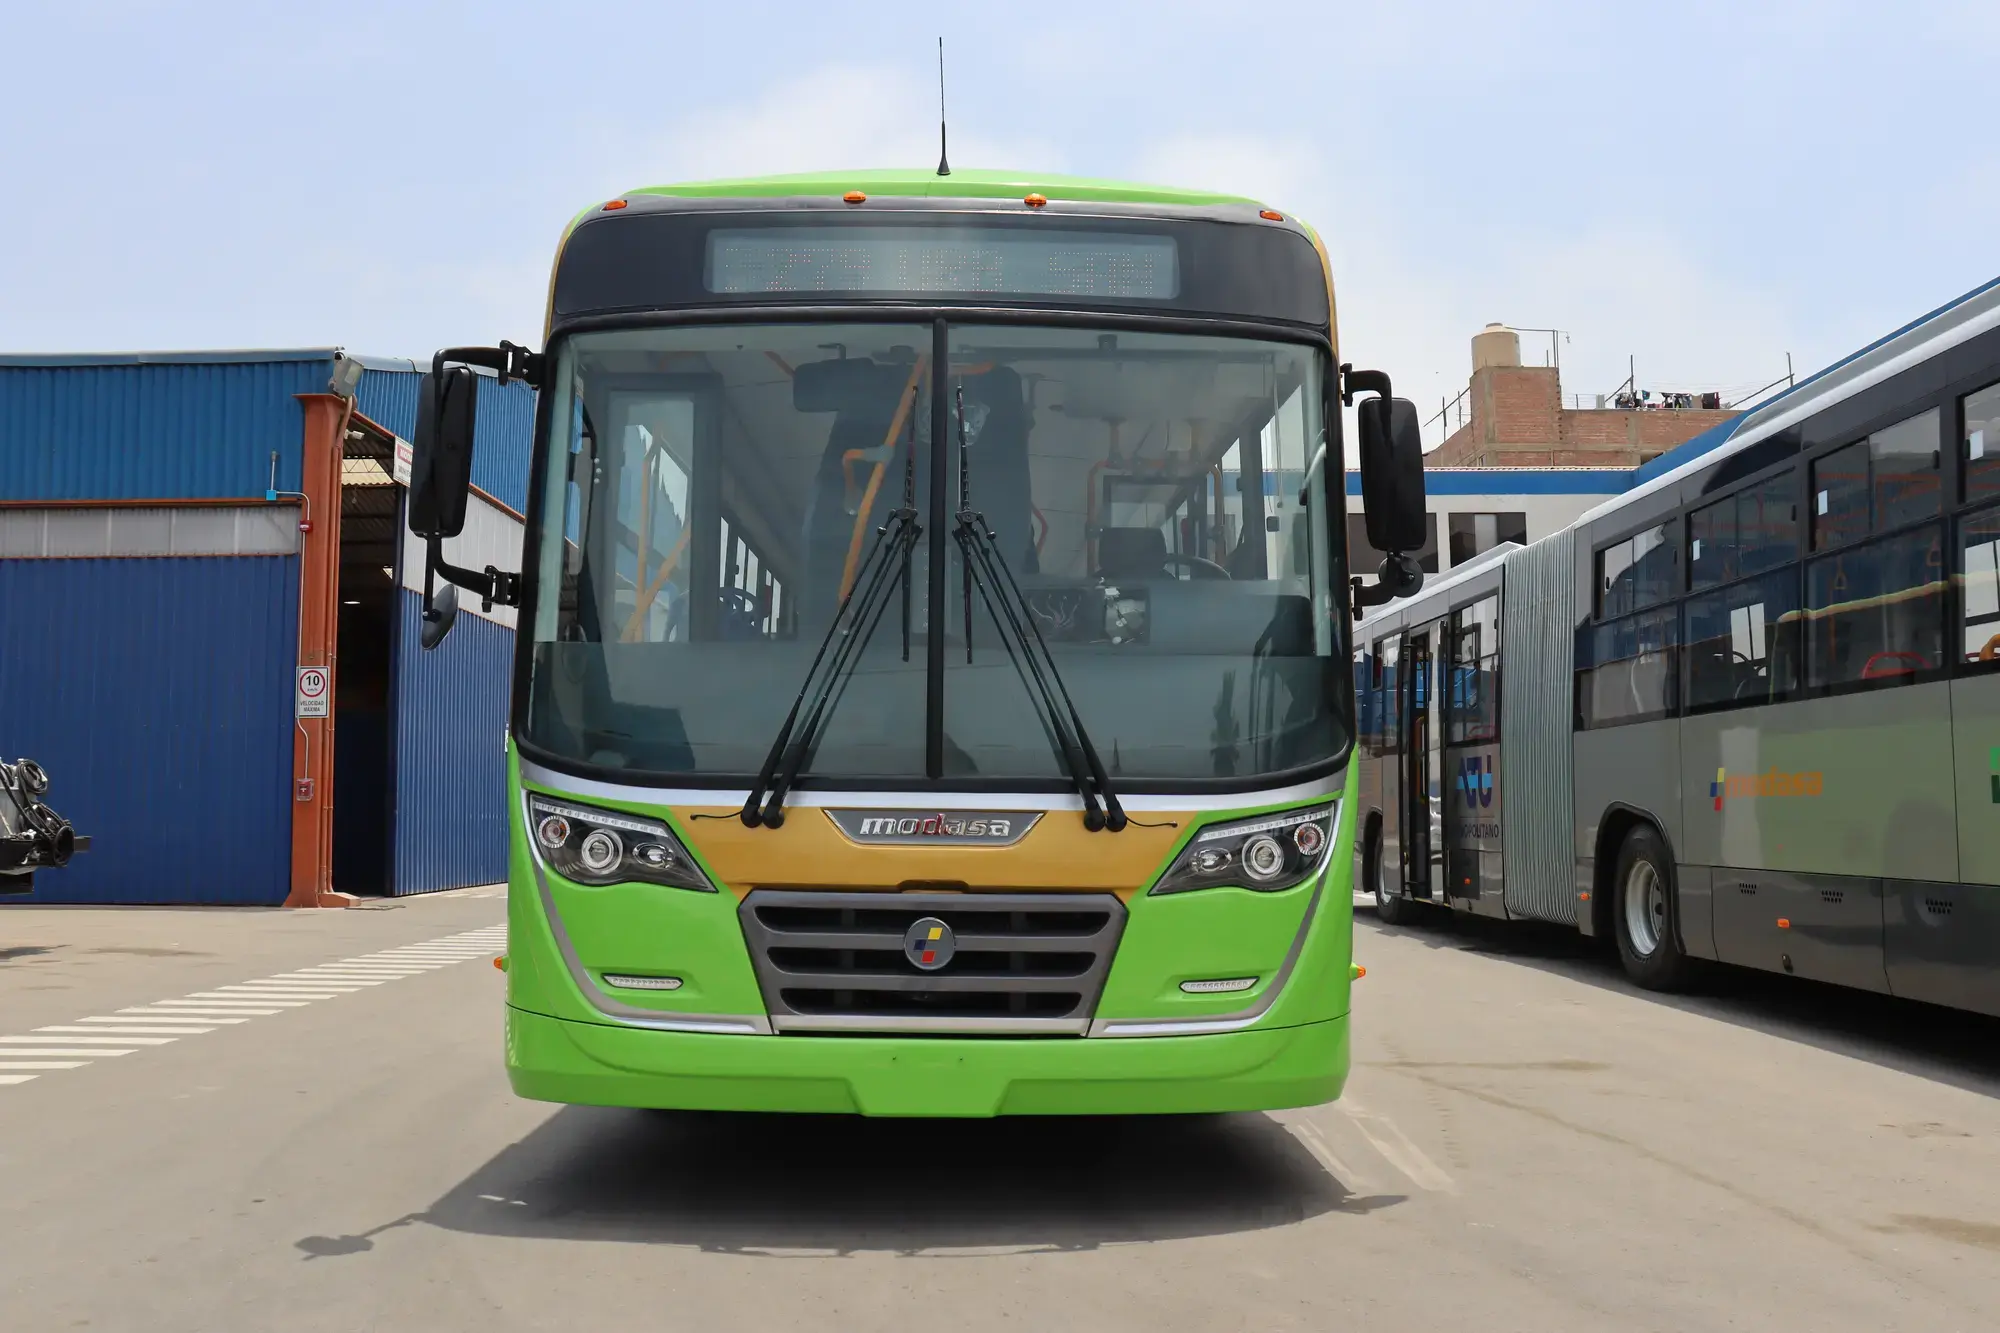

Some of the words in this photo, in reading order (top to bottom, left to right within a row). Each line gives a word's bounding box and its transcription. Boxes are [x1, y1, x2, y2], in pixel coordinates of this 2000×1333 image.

[306, 675, 320, 686] 10
[1724, 765, 1823, 797] modasa
[860, 813, 1011, 837] modasa
